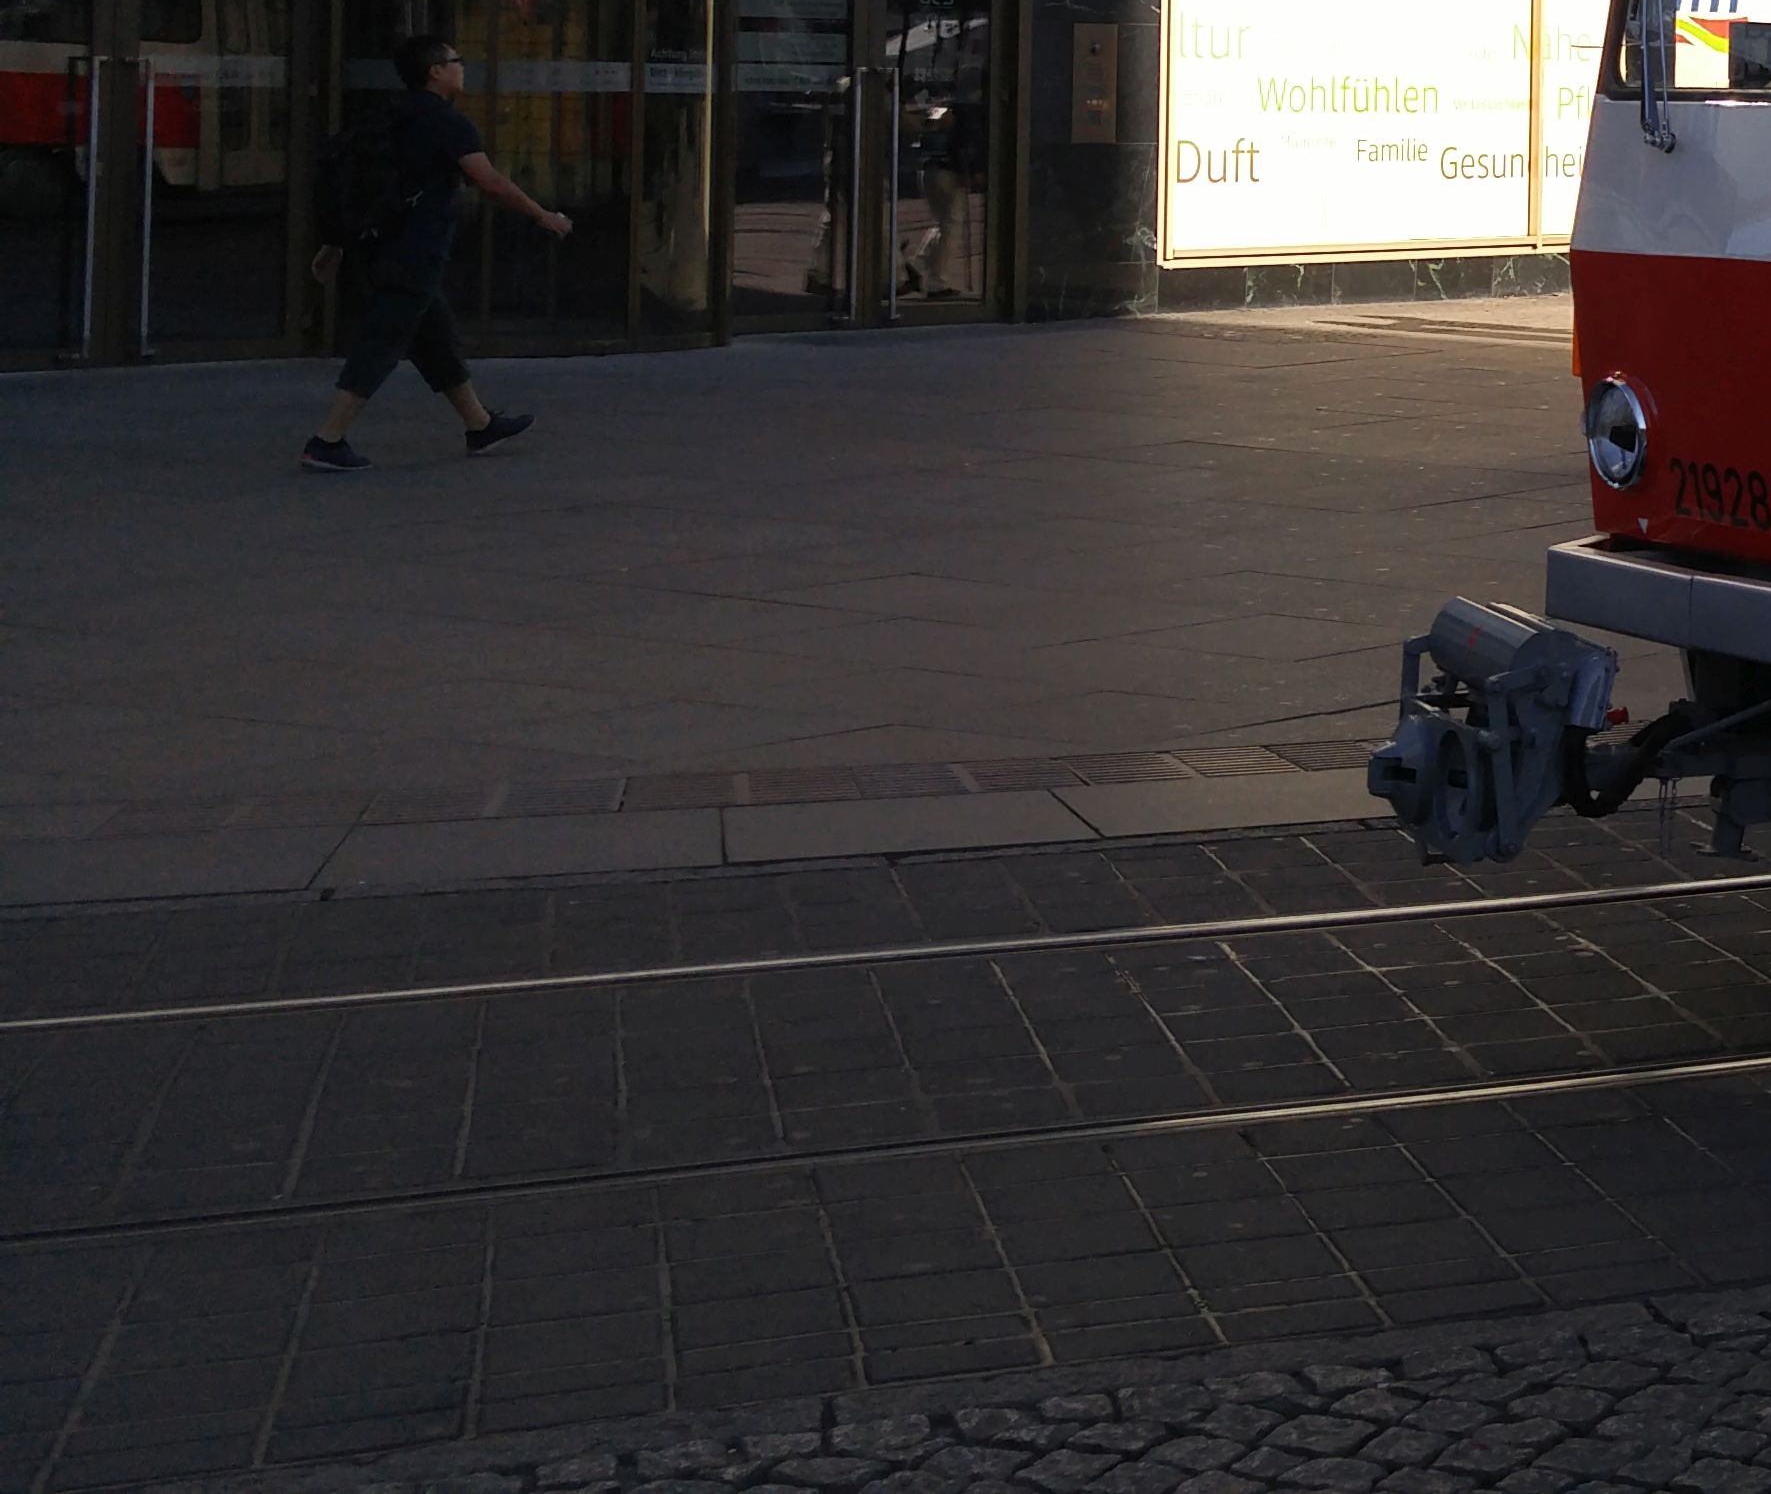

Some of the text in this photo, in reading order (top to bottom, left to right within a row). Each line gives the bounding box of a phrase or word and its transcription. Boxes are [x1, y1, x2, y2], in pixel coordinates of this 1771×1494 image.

[1256, 74, 1439, 114] Wohlfühlen
[1176, 138, 1261, 185] Duft
[1356, 137, 1430, 163] Familie
